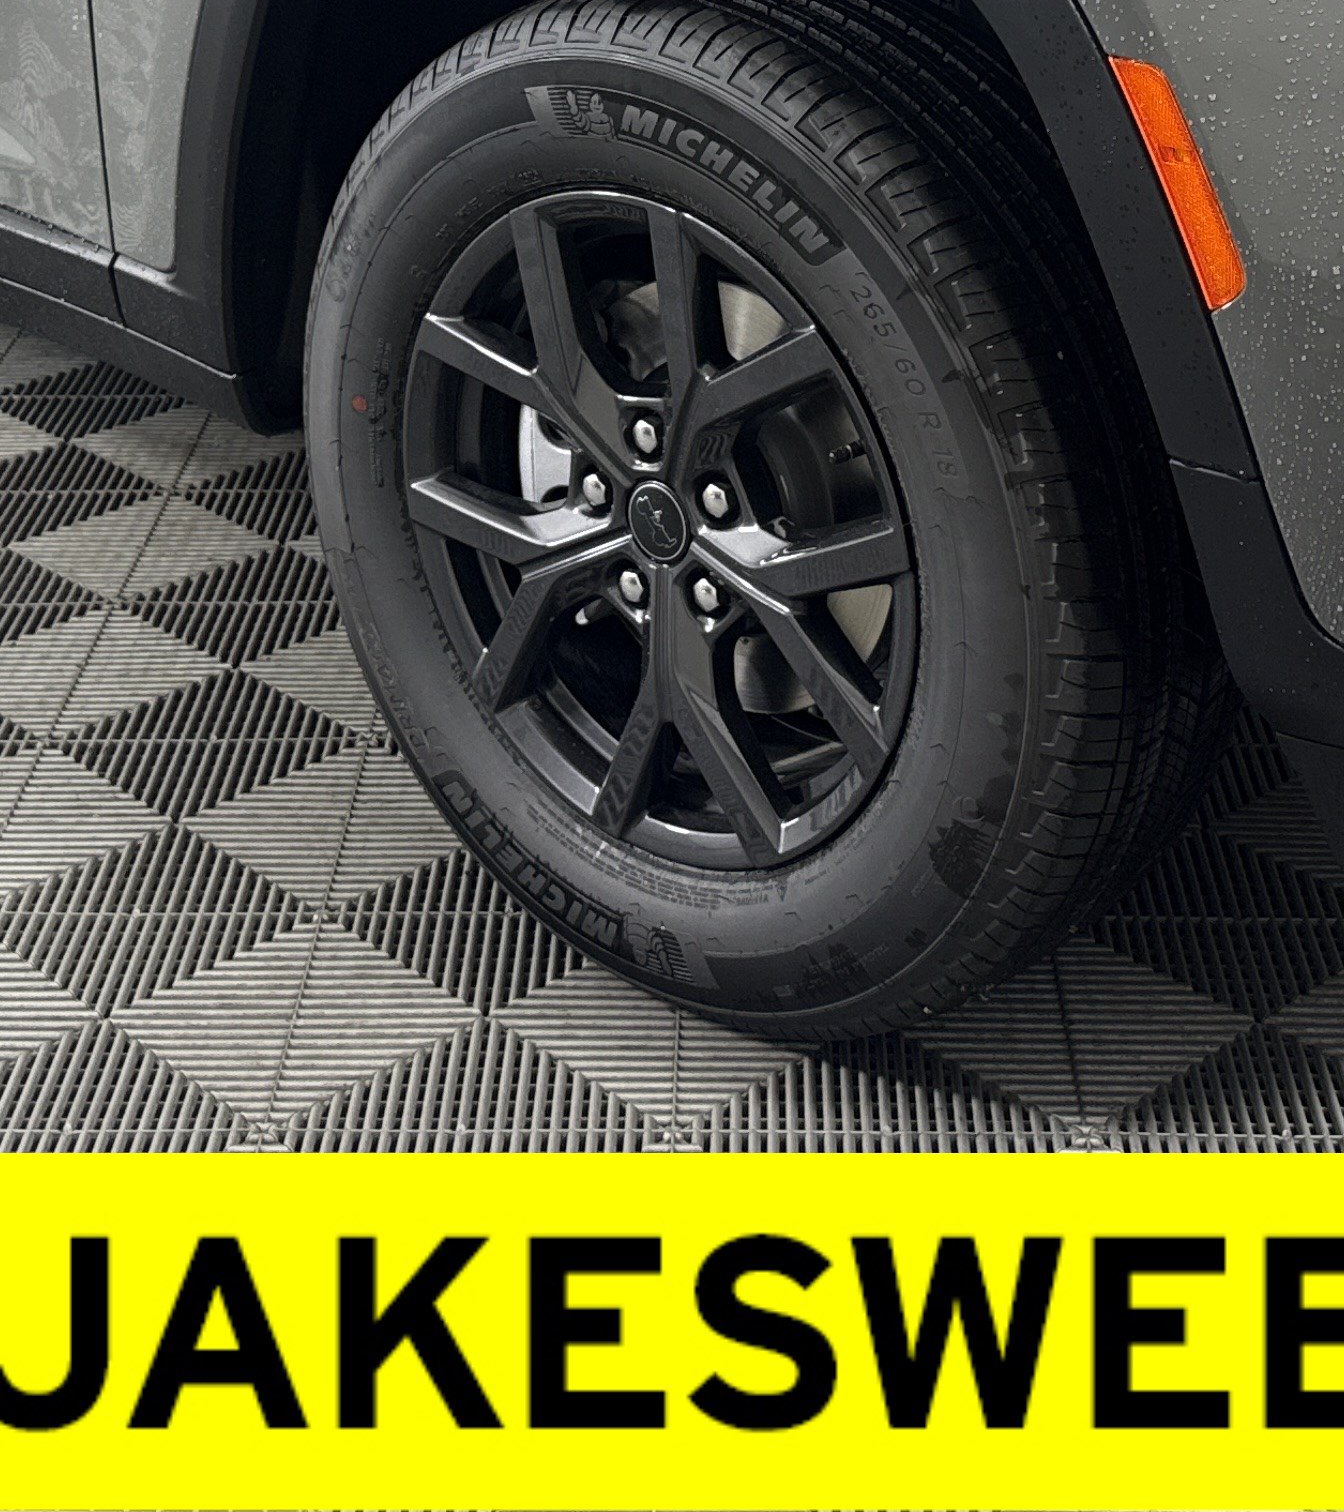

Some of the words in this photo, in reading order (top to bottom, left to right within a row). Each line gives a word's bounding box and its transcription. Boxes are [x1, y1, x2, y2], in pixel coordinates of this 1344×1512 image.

[620, 104, 829, 254] MICHELIN
[849, 285, 927, 396] 265/60
[442, 780, 617, 949] MICHELIN
